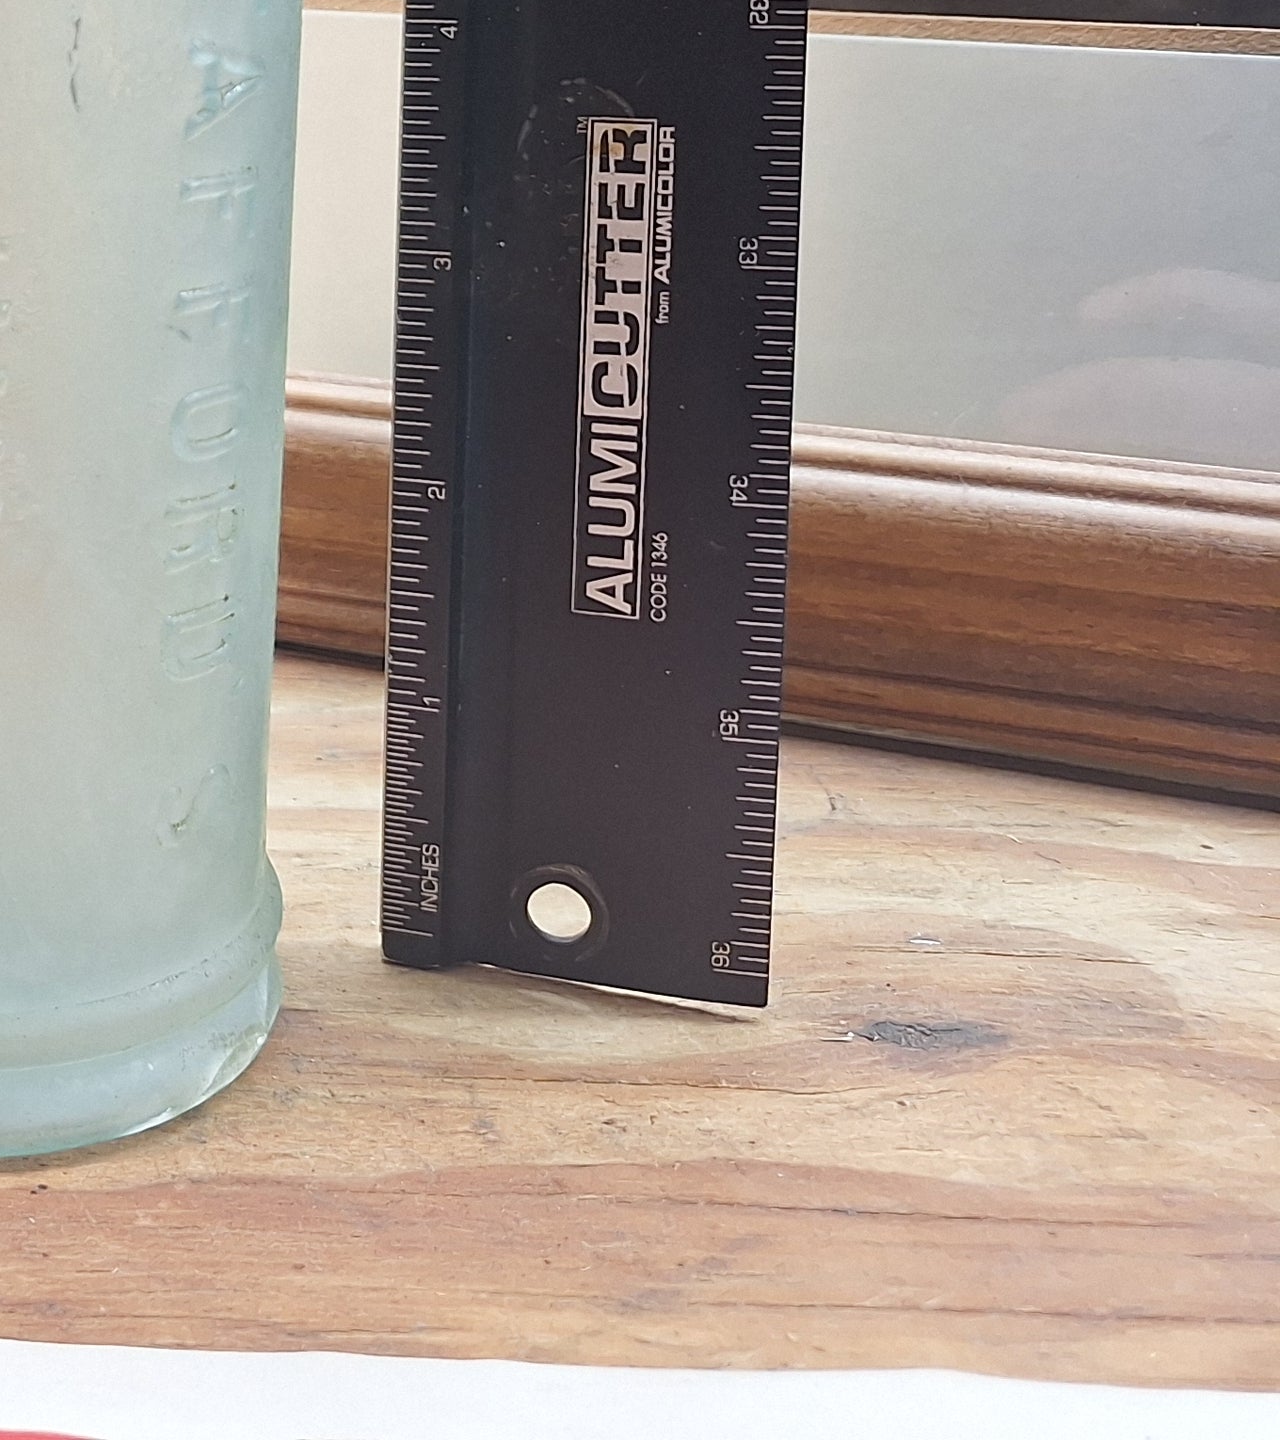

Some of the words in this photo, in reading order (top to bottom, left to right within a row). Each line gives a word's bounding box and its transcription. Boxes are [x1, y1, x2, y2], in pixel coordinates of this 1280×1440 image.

[439, 25, 458, 41] 4
[653, 125, 676, 285] ALUMICOLOR
[433, 256, 452, 271] 3
[738, 235, 759, 266] 33
[654, 291, 671, 325] from
[584, 127, 648, 616] ALUMICUTTER
[428, 485, 446, 501] 2
[728, 473, 749, 503] 34
[650, 531, 669, 568] 1346
[649, 572, 668, 623] CODE
[719, 708, 739, 737] 35
[419, 843, 441, 914] INCHES
[710, 940, 730, 968] 36
